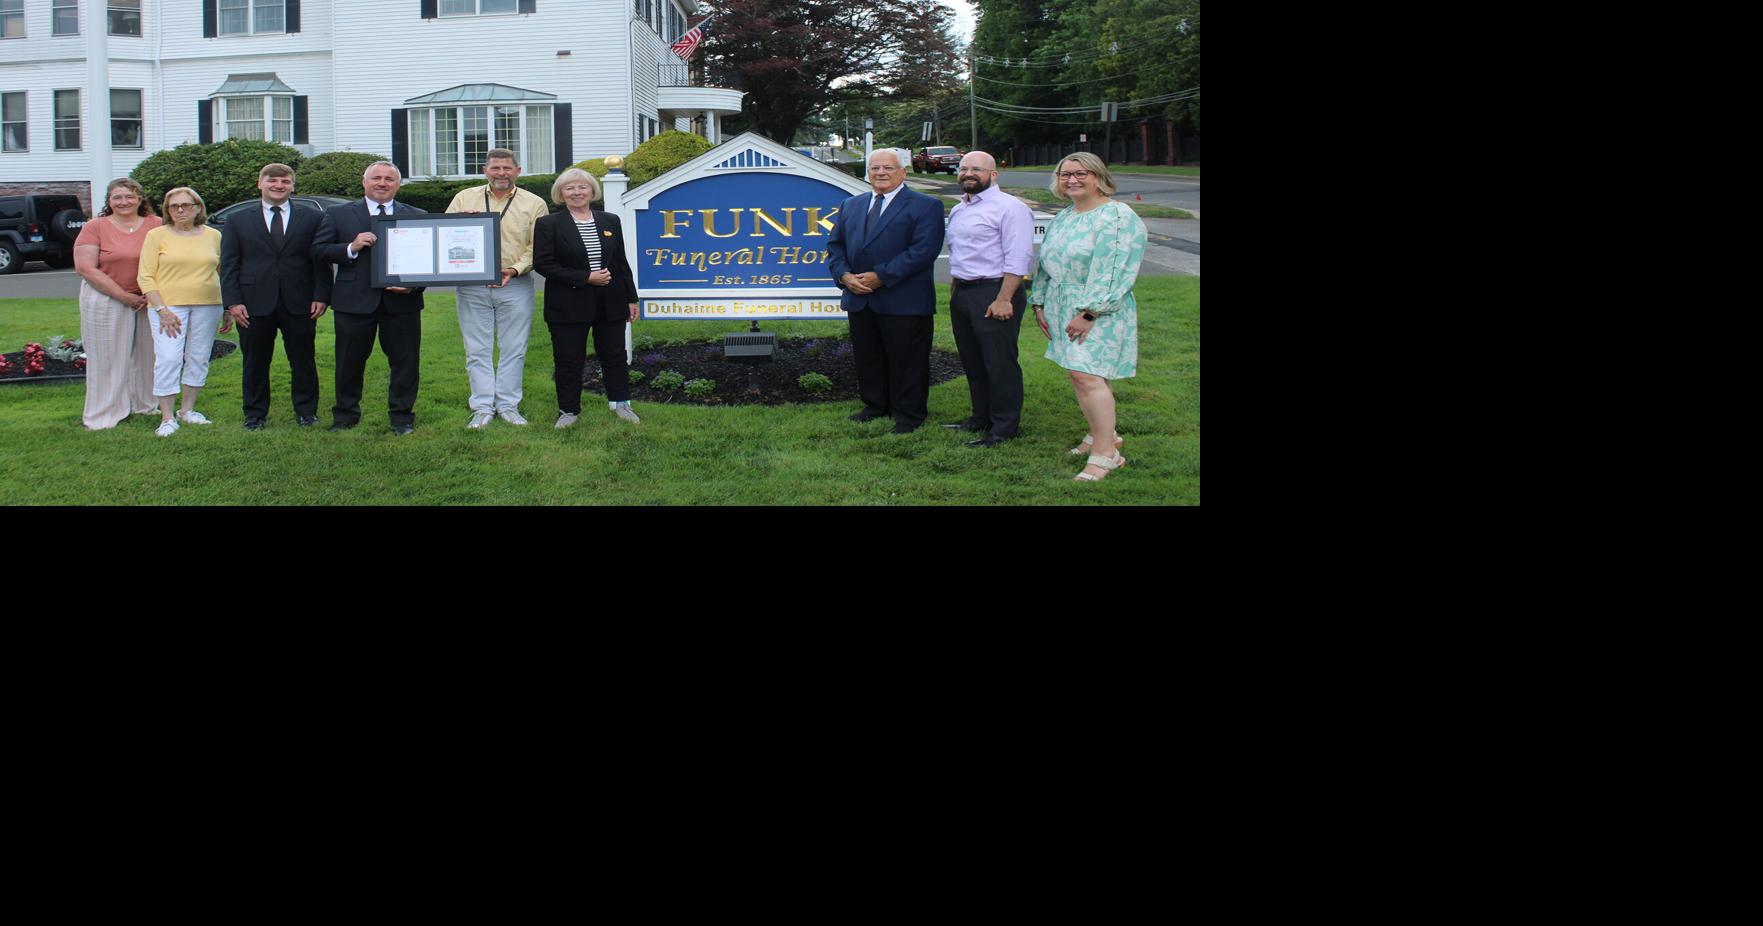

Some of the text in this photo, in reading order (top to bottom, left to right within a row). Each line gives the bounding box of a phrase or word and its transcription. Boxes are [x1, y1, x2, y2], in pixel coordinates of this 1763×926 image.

[659, 207, 841, 239] FUNK
[645, 246, 764, 272] Funeral
[712, 275, 793, 285] Est. 1865
[647, 302, 727, 314] Duhaime
[733, 301, 803, 313] Funeral
